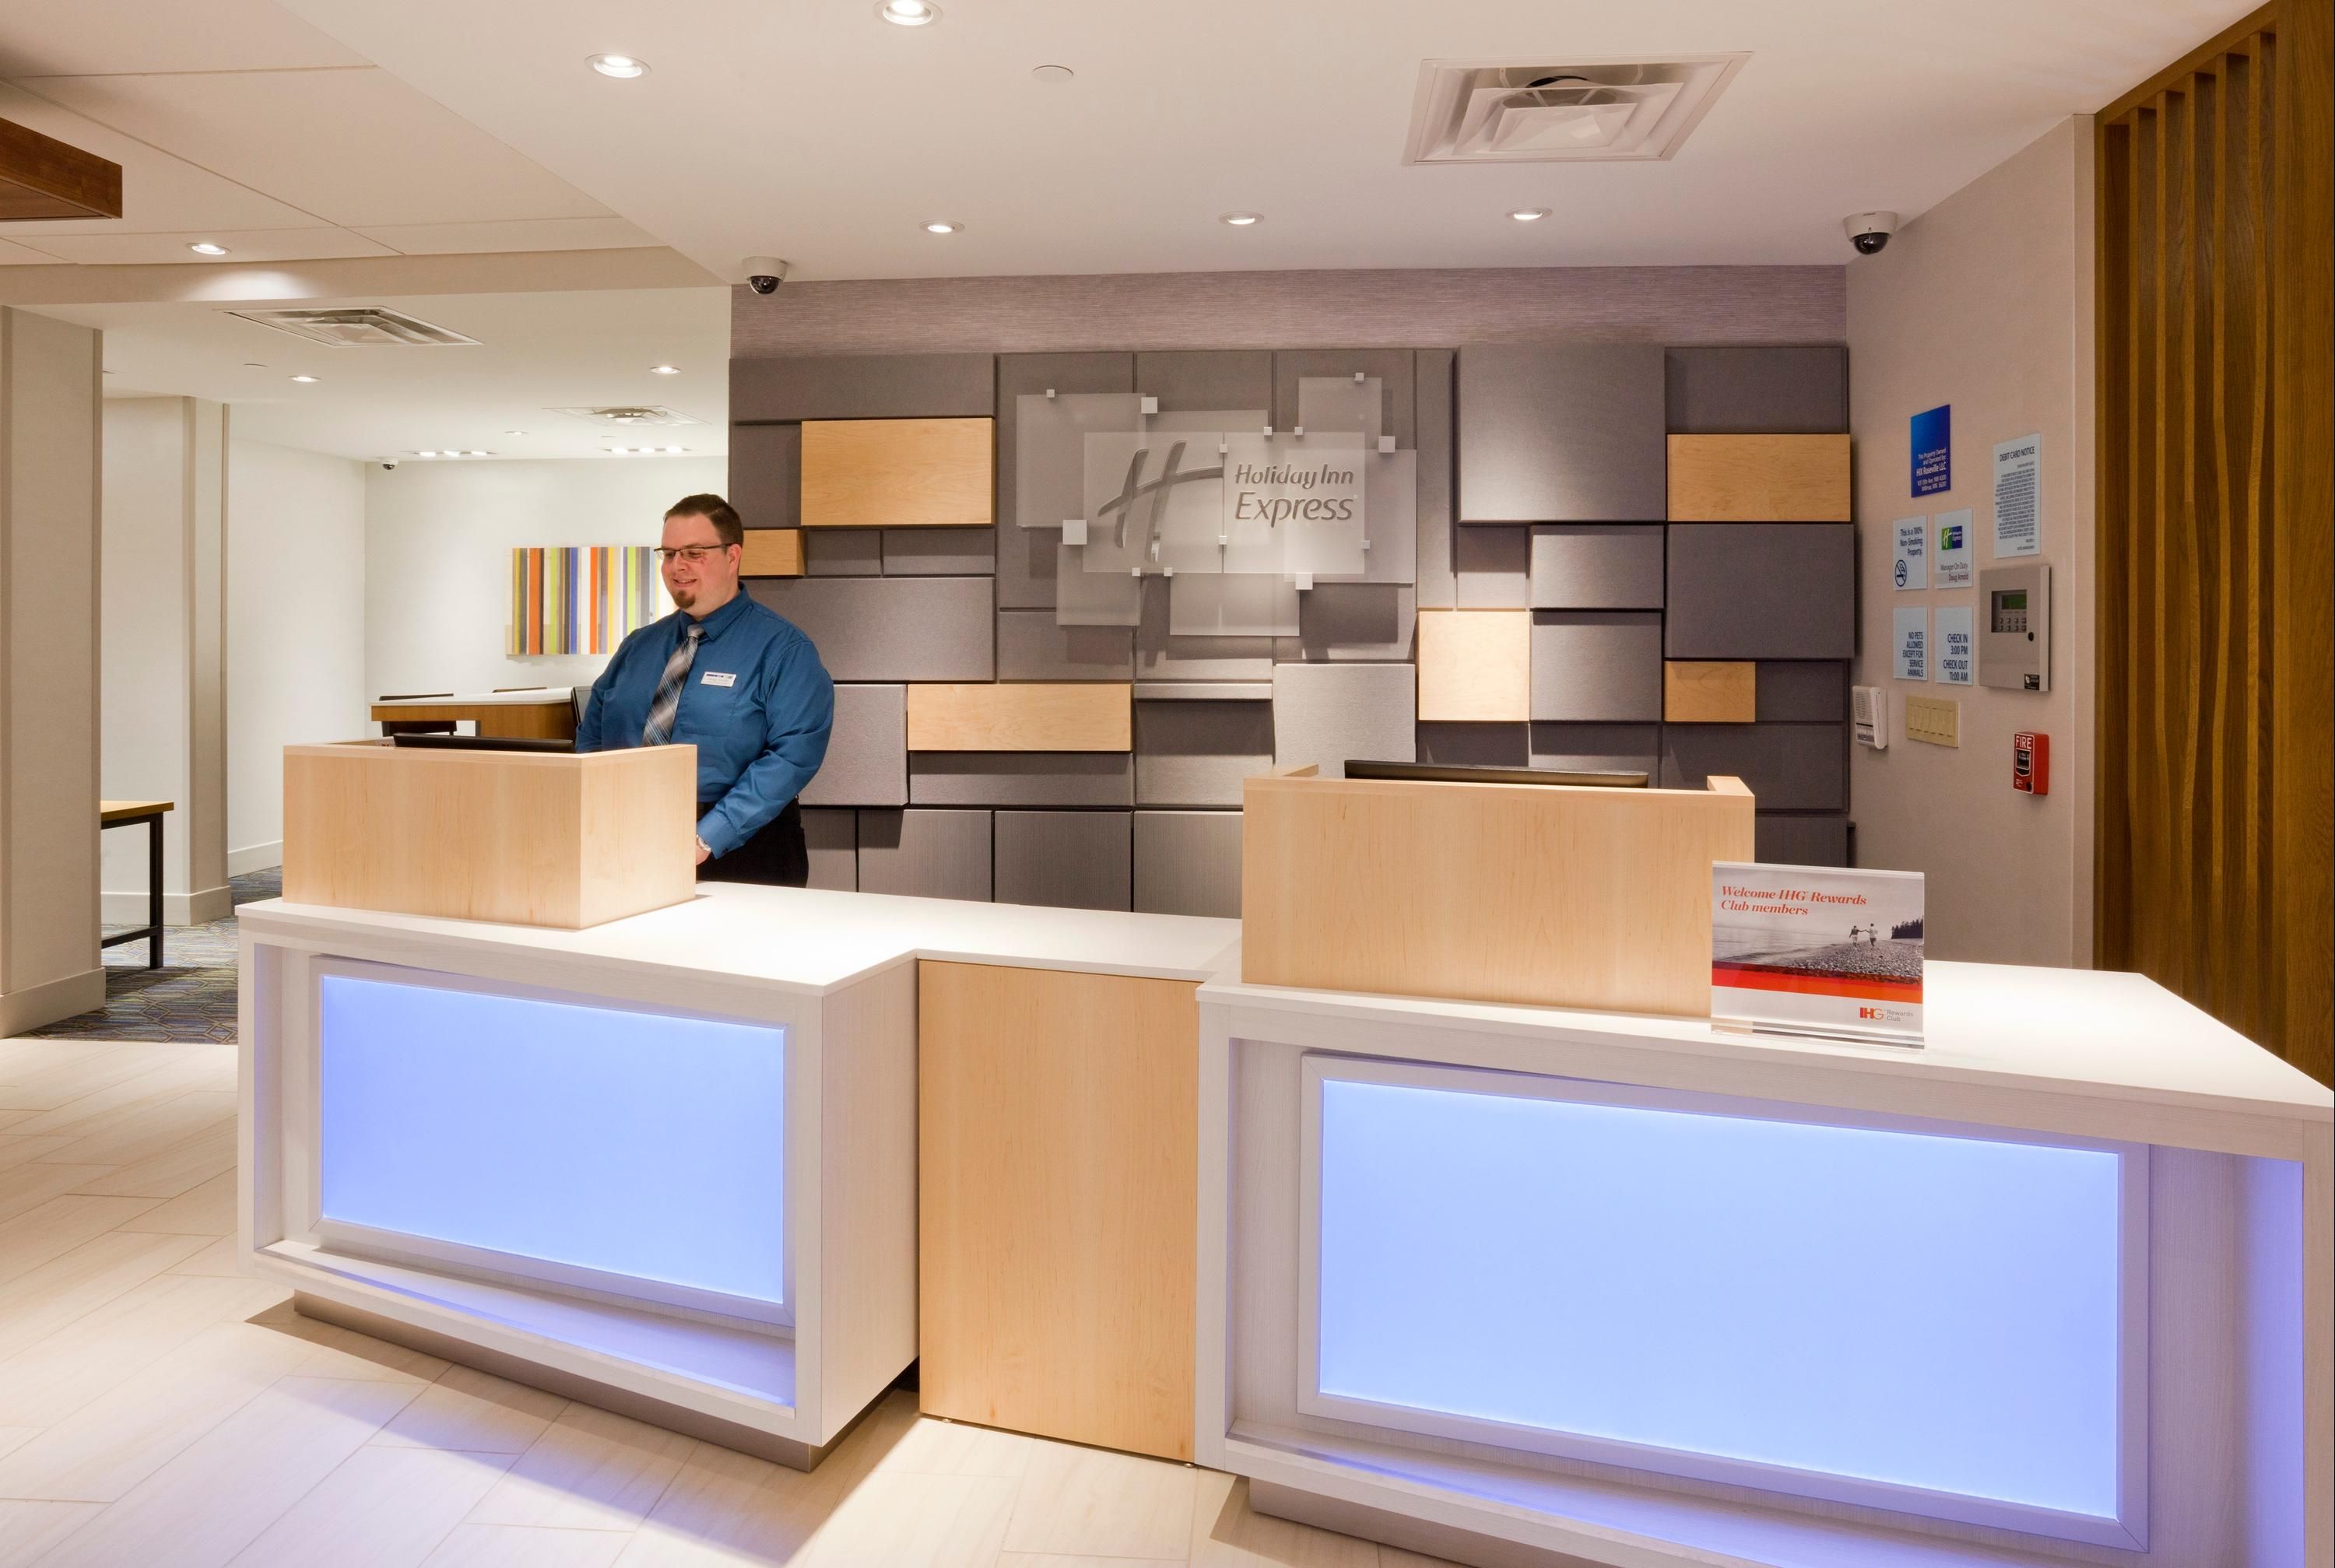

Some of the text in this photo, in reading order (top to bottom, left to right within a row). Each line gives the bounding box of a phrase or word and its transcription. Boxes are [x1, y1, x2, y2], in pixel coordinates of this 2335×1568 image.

[1999, 446, 2035, 461] DEBIT CARD NOTICE
[1922, 464, 1939, 475] Roseville
[1234, 464, 1354, 489] Holiday Inn
[1235, 492, 1354, 528] Express
[1900, 538, 1922, 546] Non-Smoking
[1948, 574, 1958, 582] Doug
[1908, 631, 1923, 640] NO PETS
[1947, 633, 1968, 644] CHECK IN
[1951, 645, 1968, 655] 3:00 PM
[1909, 659, 1923, 668] SERVICE
[1943, 659, 1968, 670] CHECK OUT
[1907, 668, 1923, 677] ANIMALS
[1949, 672, 1968, 682] 11:00 AM
[2015, 735, 2032, 749] FIRE
[1722, 886, 1866, 905] Welcome IHG Rewards
[1721, 900, 1808, 915] Club members
[1859, 1007, 1884, 1020] IHG
